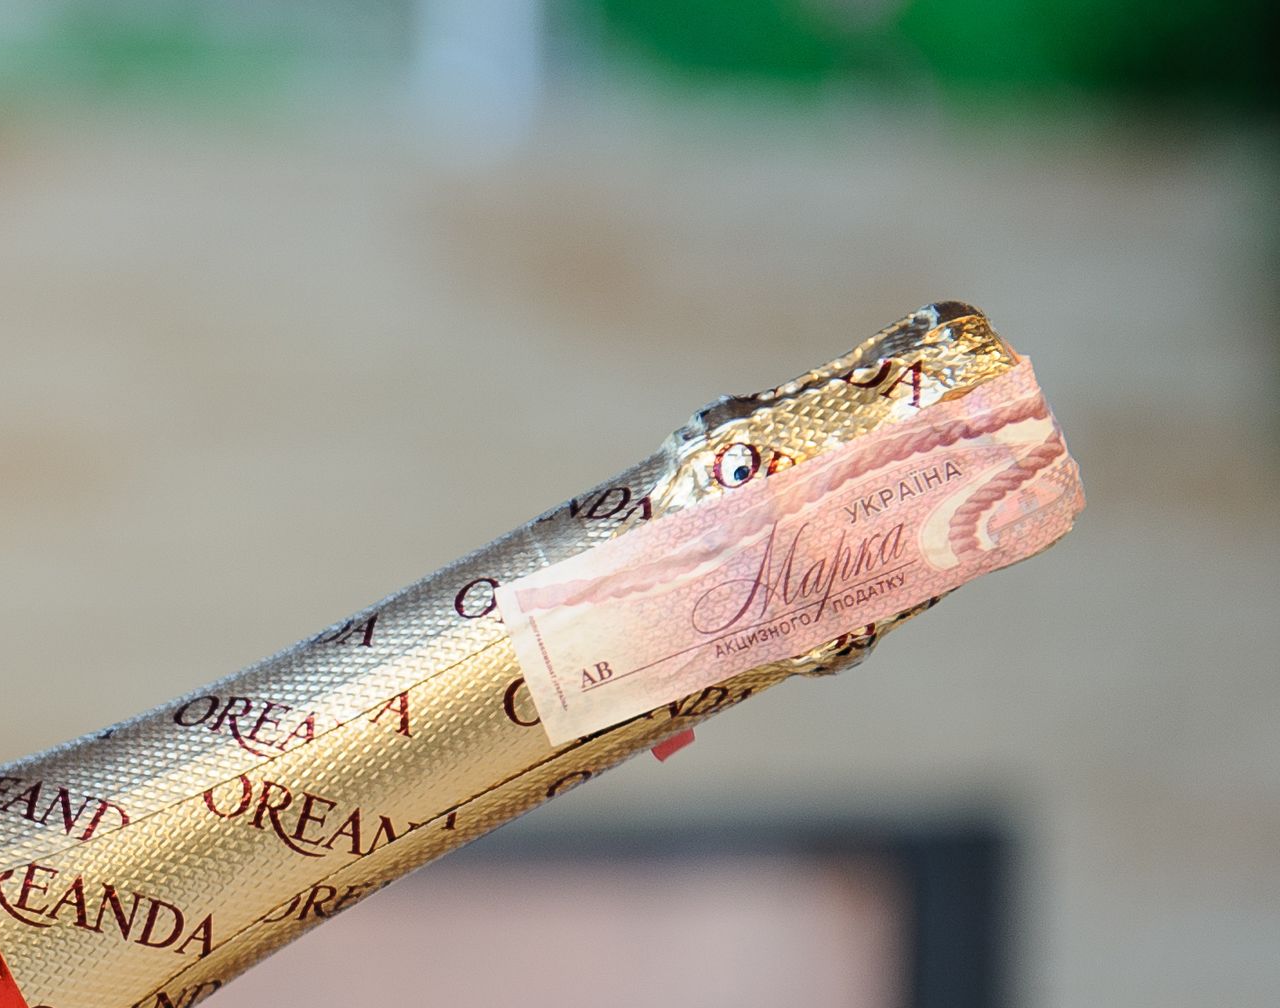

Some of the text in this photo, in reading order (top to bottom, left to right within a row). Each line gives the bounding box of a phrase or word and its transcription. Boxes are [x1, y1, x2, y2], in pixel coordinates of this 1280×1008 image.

[844, 460, 963, 524] УКРАЇНА
[692, 519, 909, 635] Марка
[715, 612, 812, 658] АКЦИЗНОГО
[831, 572, 907, 614] ПОДАТКУ
